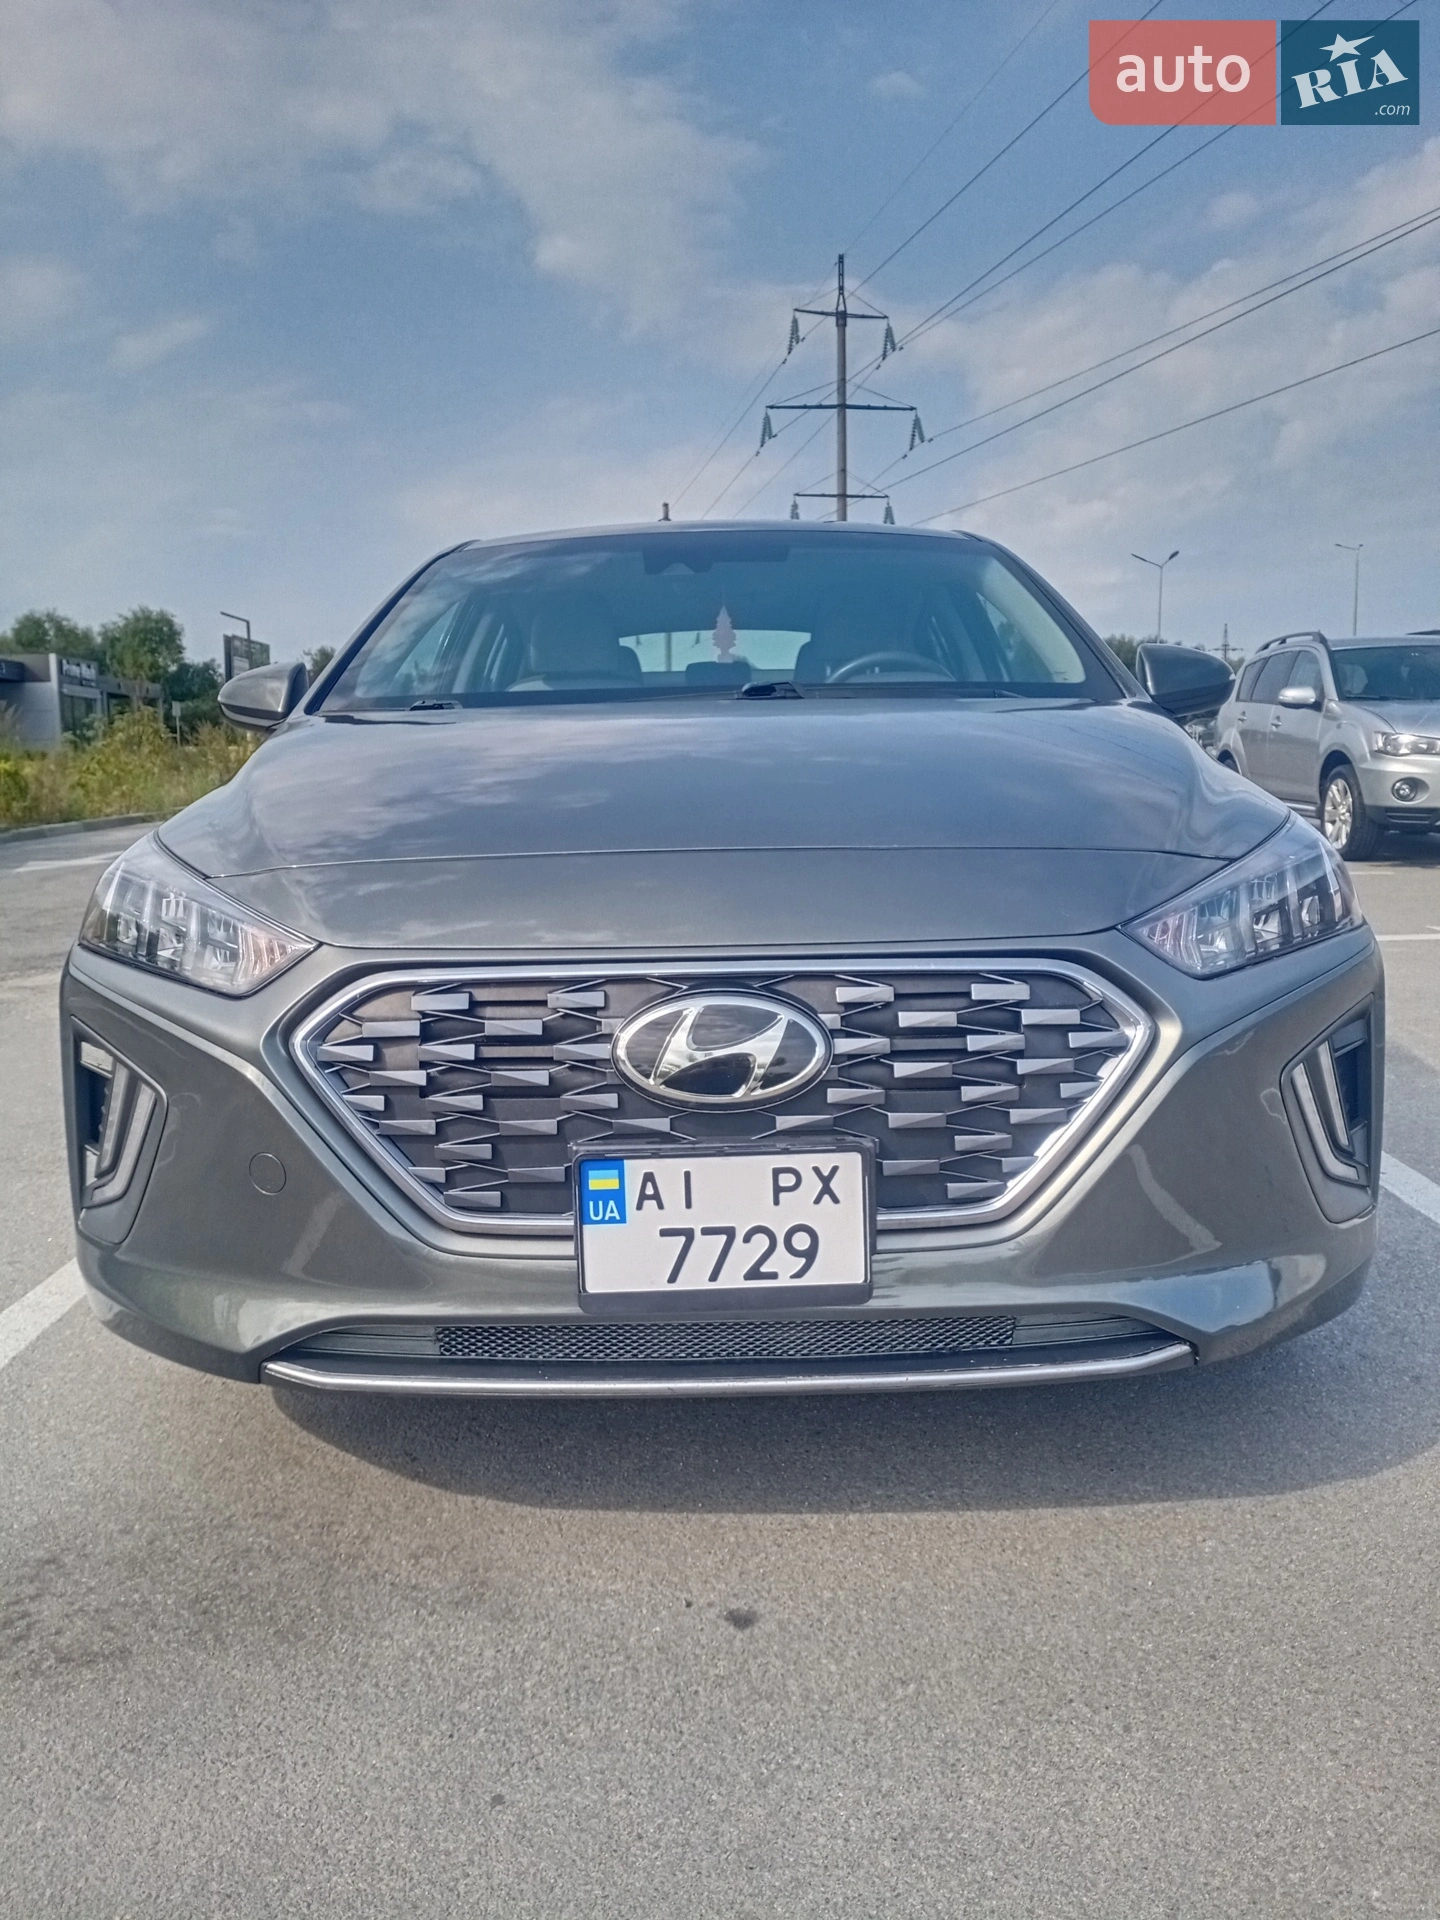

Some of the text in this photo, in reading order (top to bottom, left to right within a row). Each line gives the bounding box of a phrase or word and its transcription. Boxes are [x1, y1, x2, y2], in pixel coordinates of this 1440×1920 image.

[589, 1200, 621, 1221] UA
[635, 1165, 841, 1211] AI PX
[659, 1223, 820, 1284] 7729
